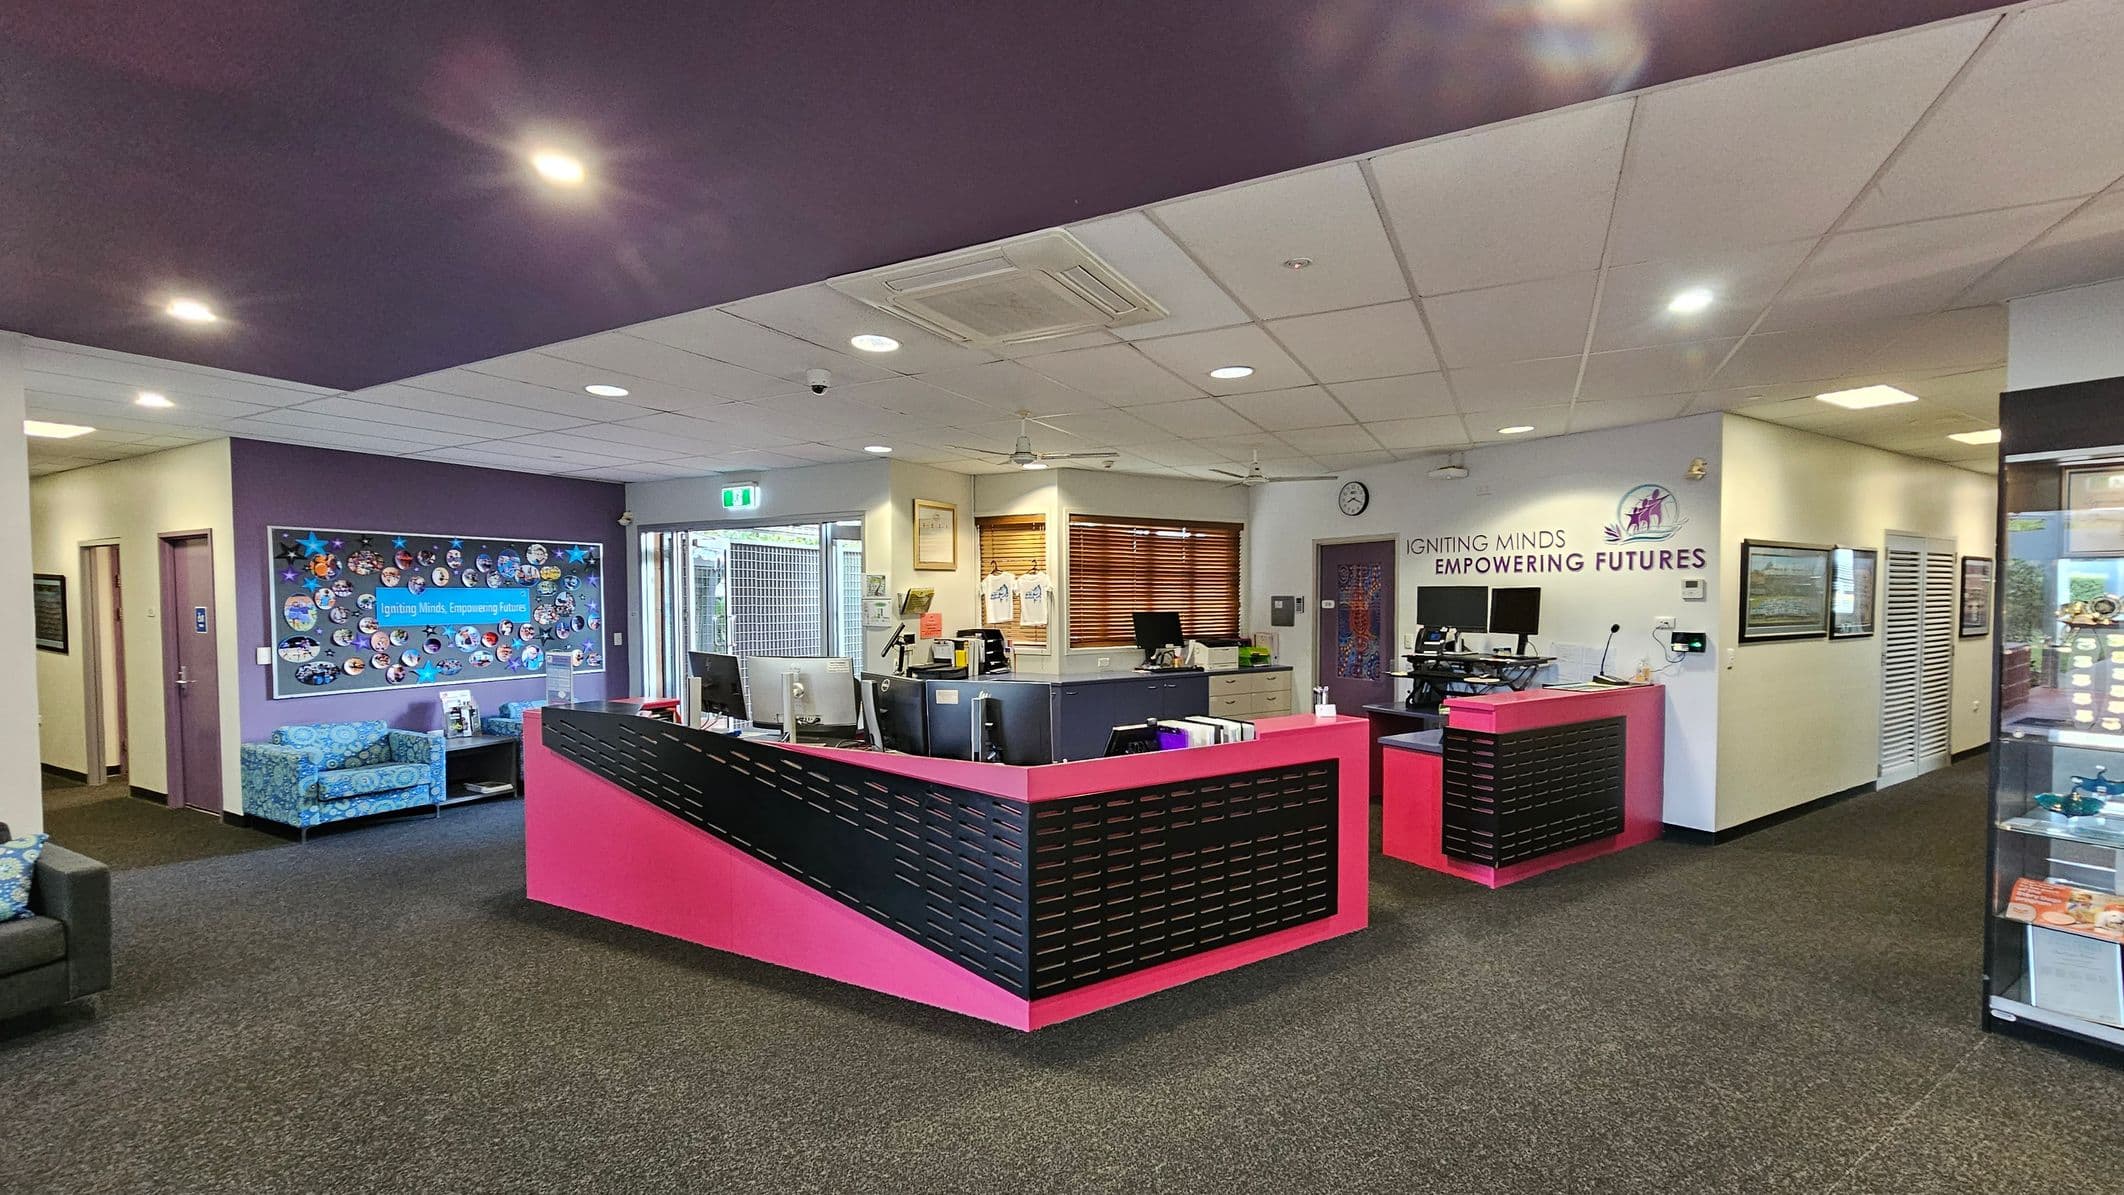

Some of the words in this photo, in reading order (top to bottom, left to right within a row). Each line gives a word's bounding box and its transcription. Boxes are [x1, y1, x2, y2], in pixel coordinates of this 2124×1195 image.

[1406, 535, 1488, 555] IGNITING
[1496, 530, 1566, 551] MINDS
[1435, 553, 1584, 575] EMPOWERING
[1595, 548, 1706, 571] FUTURES
[381, 603, 417, 617] Igniting
[450, 602, 498, 615] Empowering
[500, 602, 526, 612] Futures
